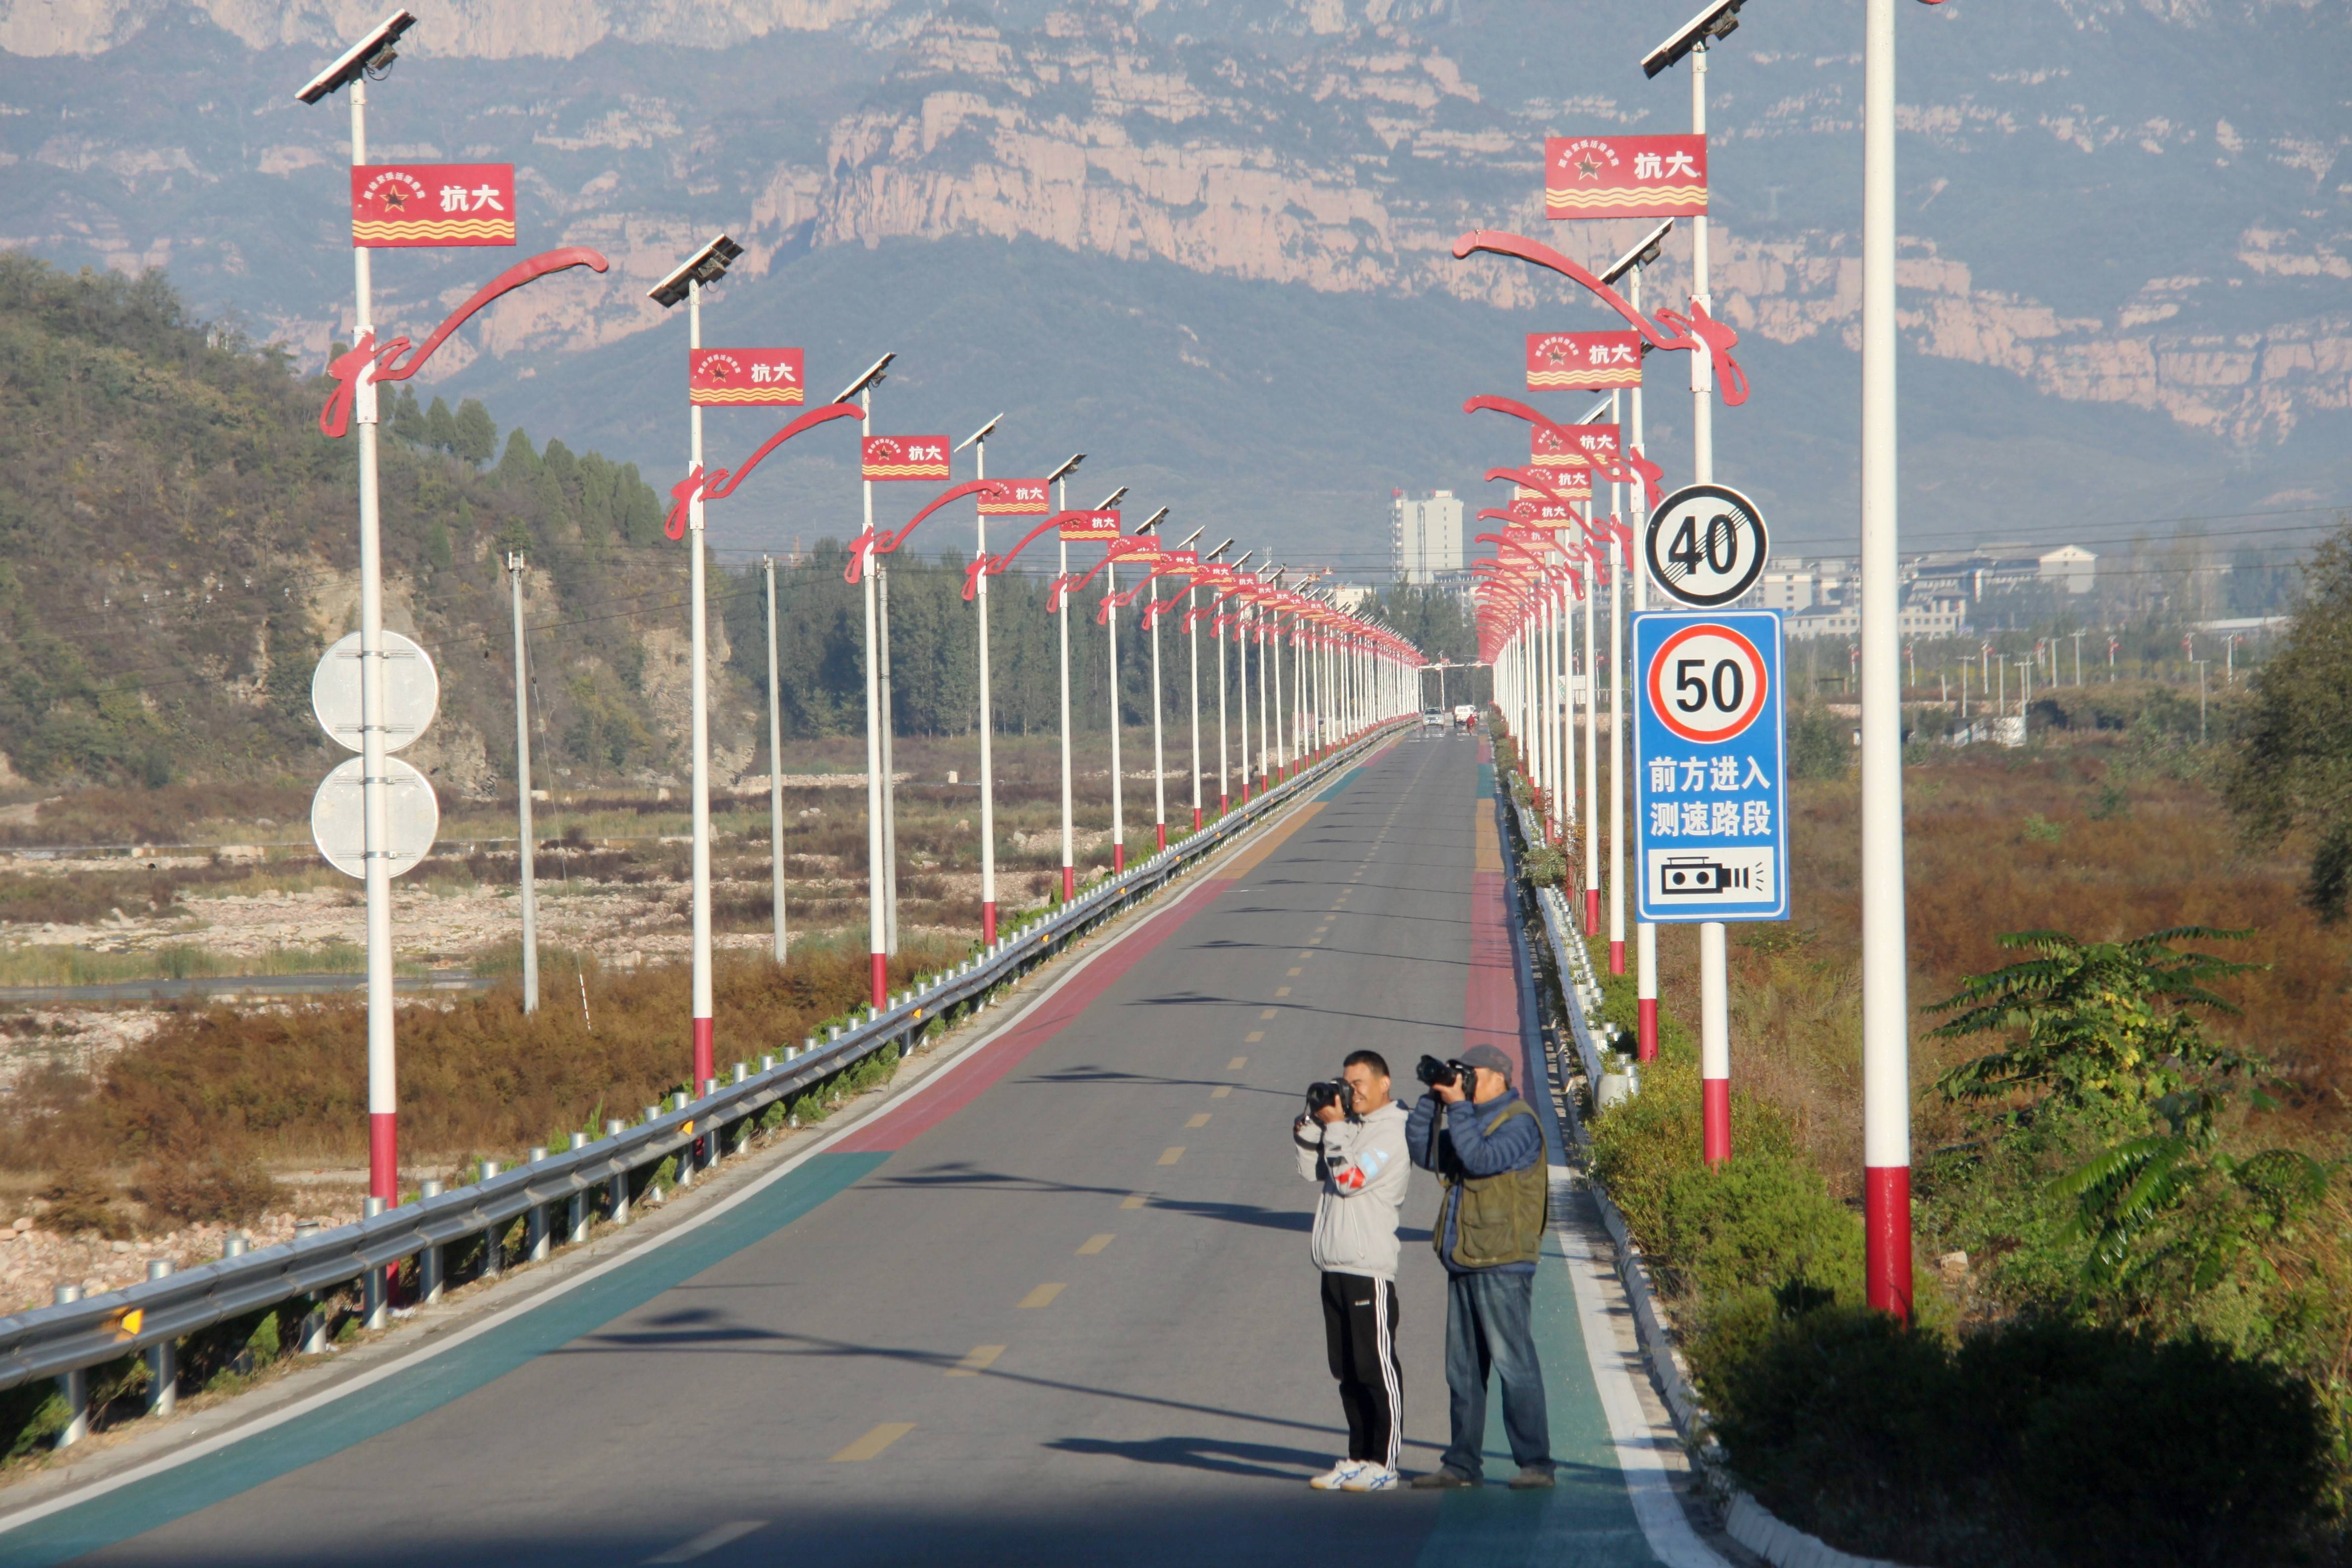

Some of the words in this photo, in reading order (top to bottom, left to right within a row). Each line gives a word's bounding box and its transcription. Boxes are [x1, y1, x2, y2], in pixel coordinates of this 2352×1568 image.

[1634, 152, 1699, 179] 抗大
[439, 184, 504, 212] 抗大
[1589, 344, 1635, 364] 抗大
[751, 363, 795, 383] 抗大
[1580, 434, 1616, 450] 抗大
[908, 445, 943, 461] 抗大
[1559, 473, 1588, 486] 抗大
[1016, 488, 1044, 500] 抗大
[1542, 506, 1566, 517] 抗大
[1092, 518, 1116, 528] 抗大
[1668, 514, 1737, 574] 40
[1676, 659, 1744, 713] 50
[1649, 756, 1771, 792] 前方进入
[1651, 801, 1771, 837] 测速路段
